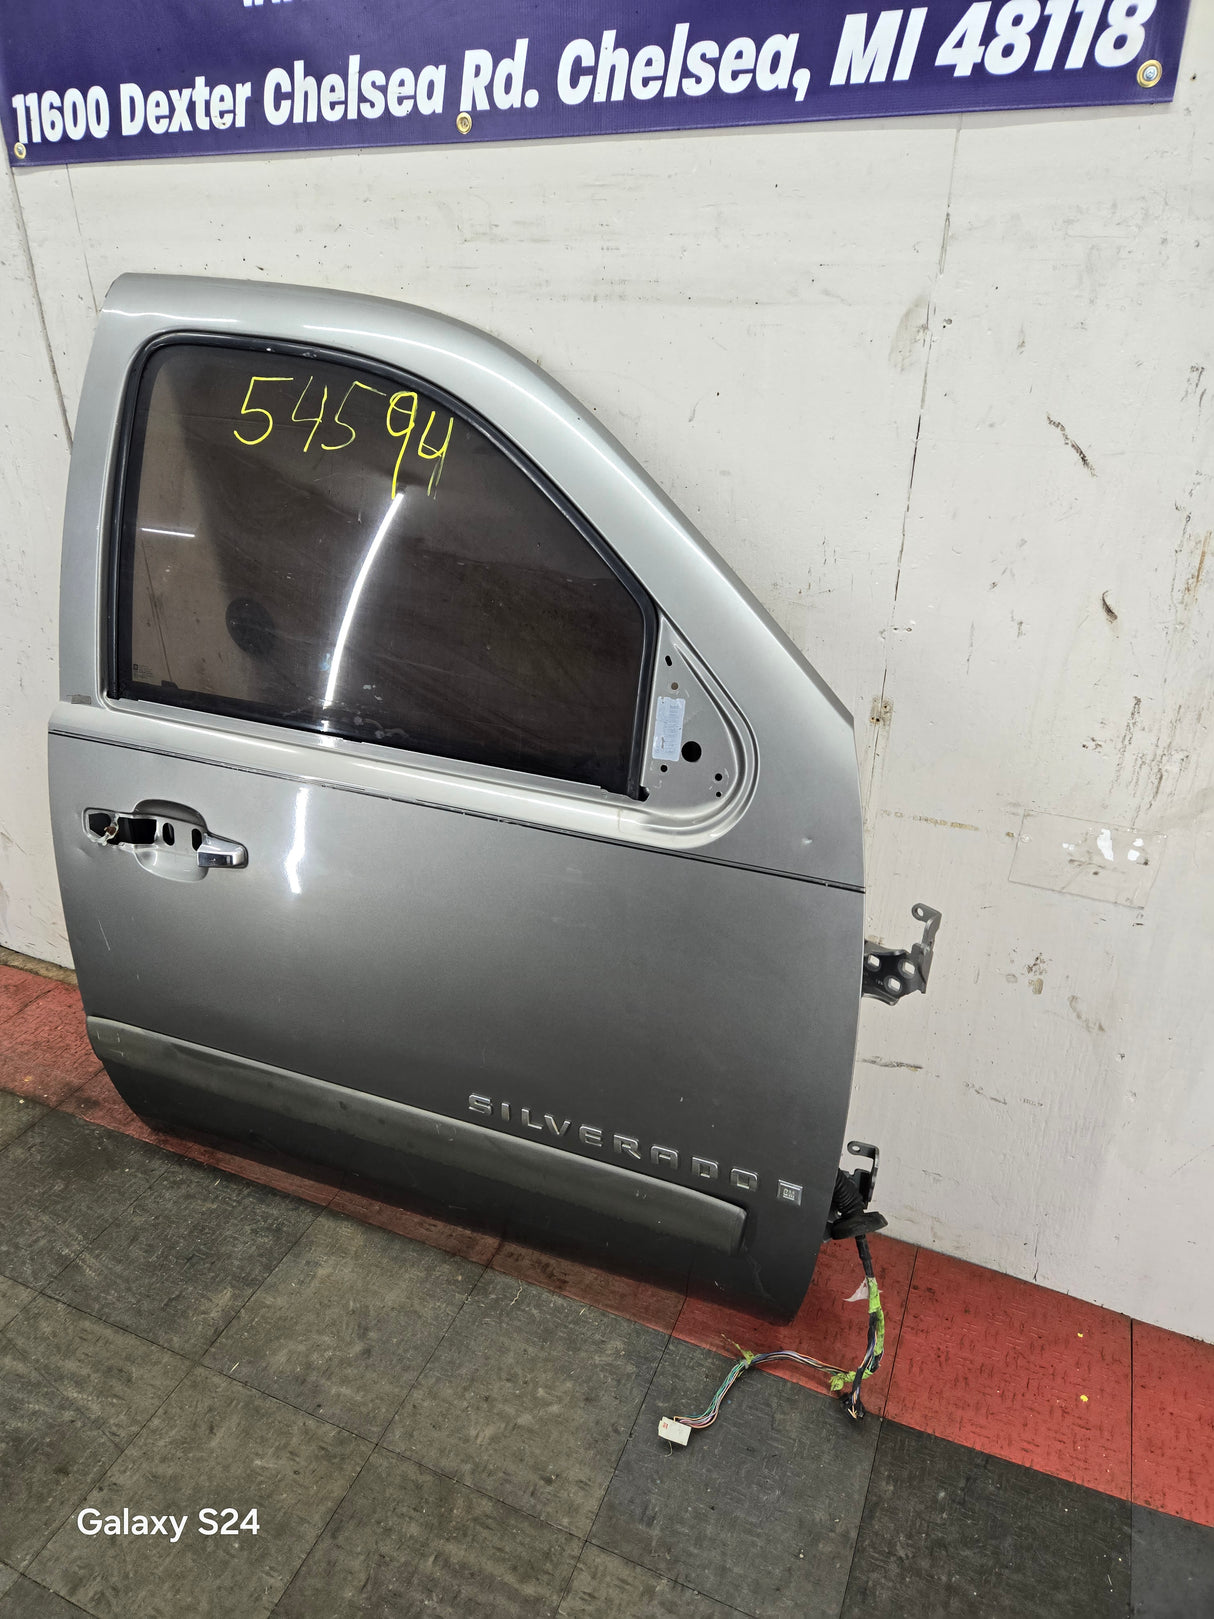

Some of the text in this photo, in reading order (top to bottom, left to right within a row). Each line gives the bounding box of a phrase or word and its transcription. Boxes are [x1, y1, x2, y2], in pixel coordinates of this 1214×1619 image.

[12, 0, 1156, 144] 11600 Dexter Chelsea Rd. Chelsea, MI 48118
[233, 376, 453, 499] 54594
[468, 1093, 759, 1193] SILVERADO
